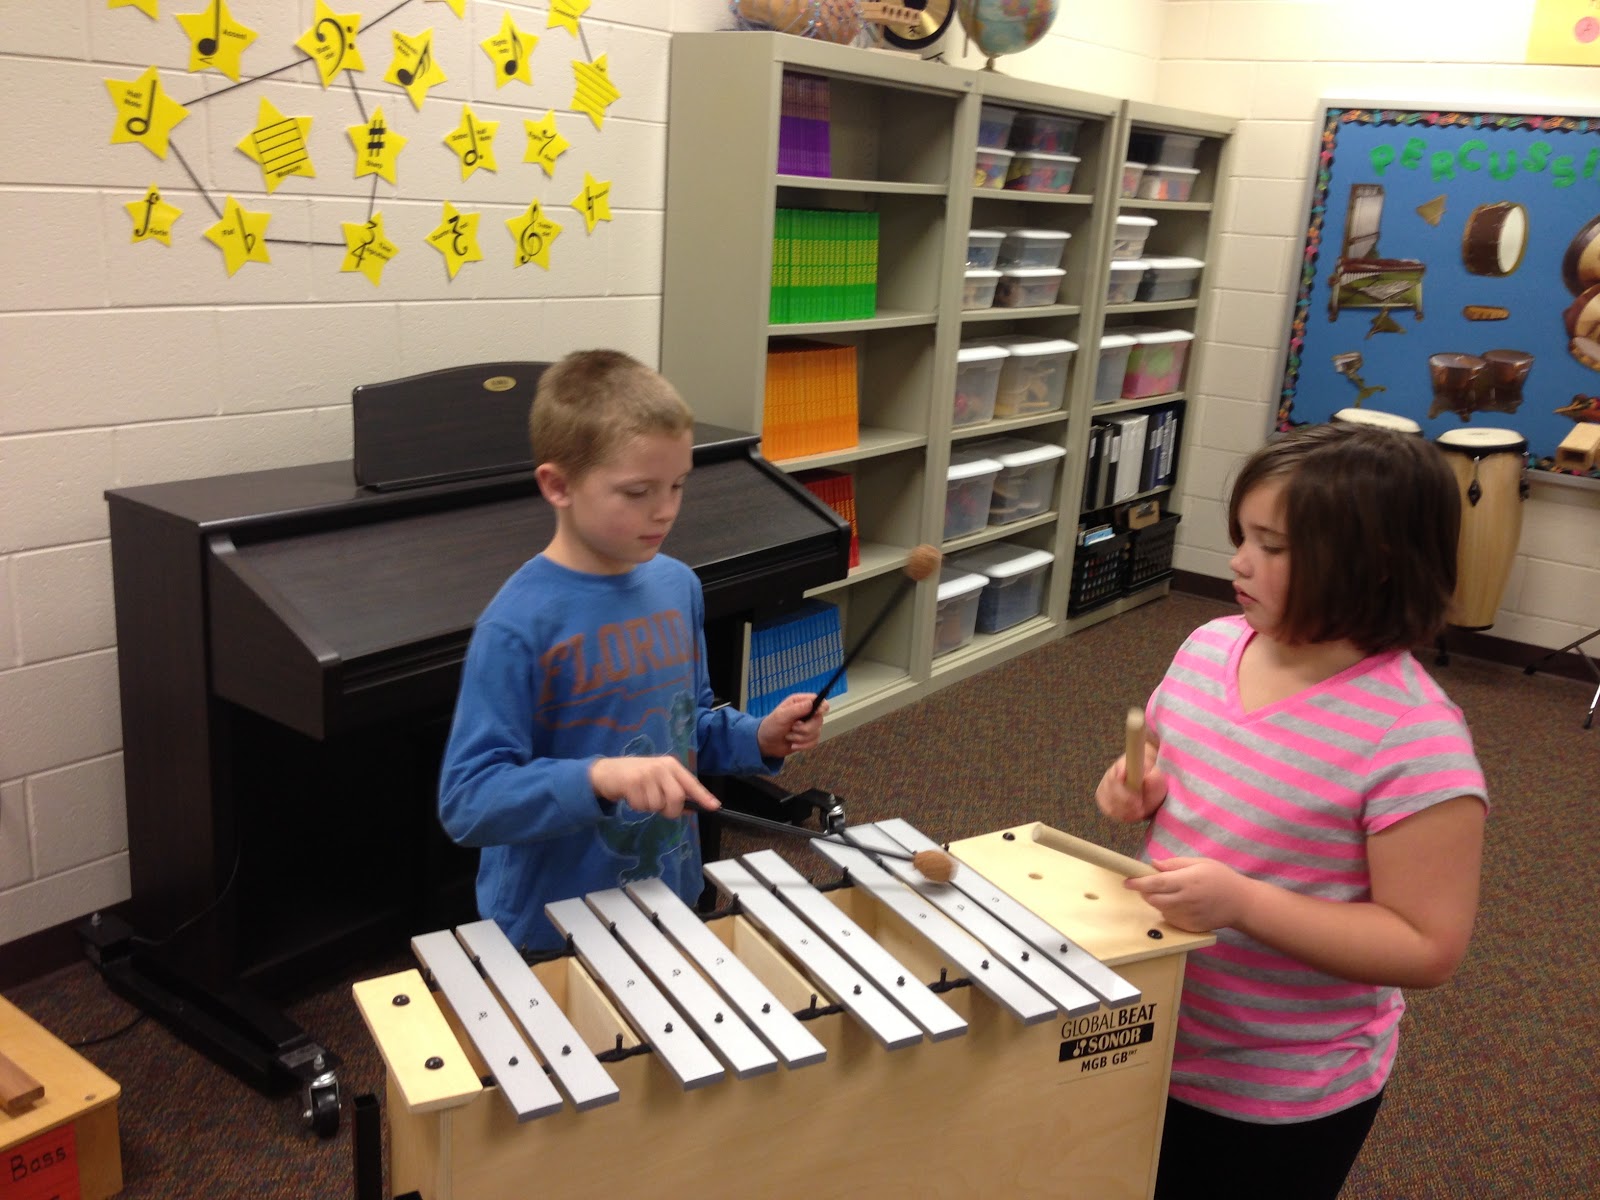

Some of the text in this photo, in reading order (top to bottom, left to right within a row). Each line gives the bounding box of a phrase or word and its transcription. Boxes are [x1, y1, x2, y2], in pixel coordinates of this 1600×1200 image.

[1369, 137, 1600, 188] PERCUSSI
[1087, 1027, 1141, 1053] SONOR
[1081, 1056, 1107, 1072] MGB
[10, 1147, 66, 1181] Bass
